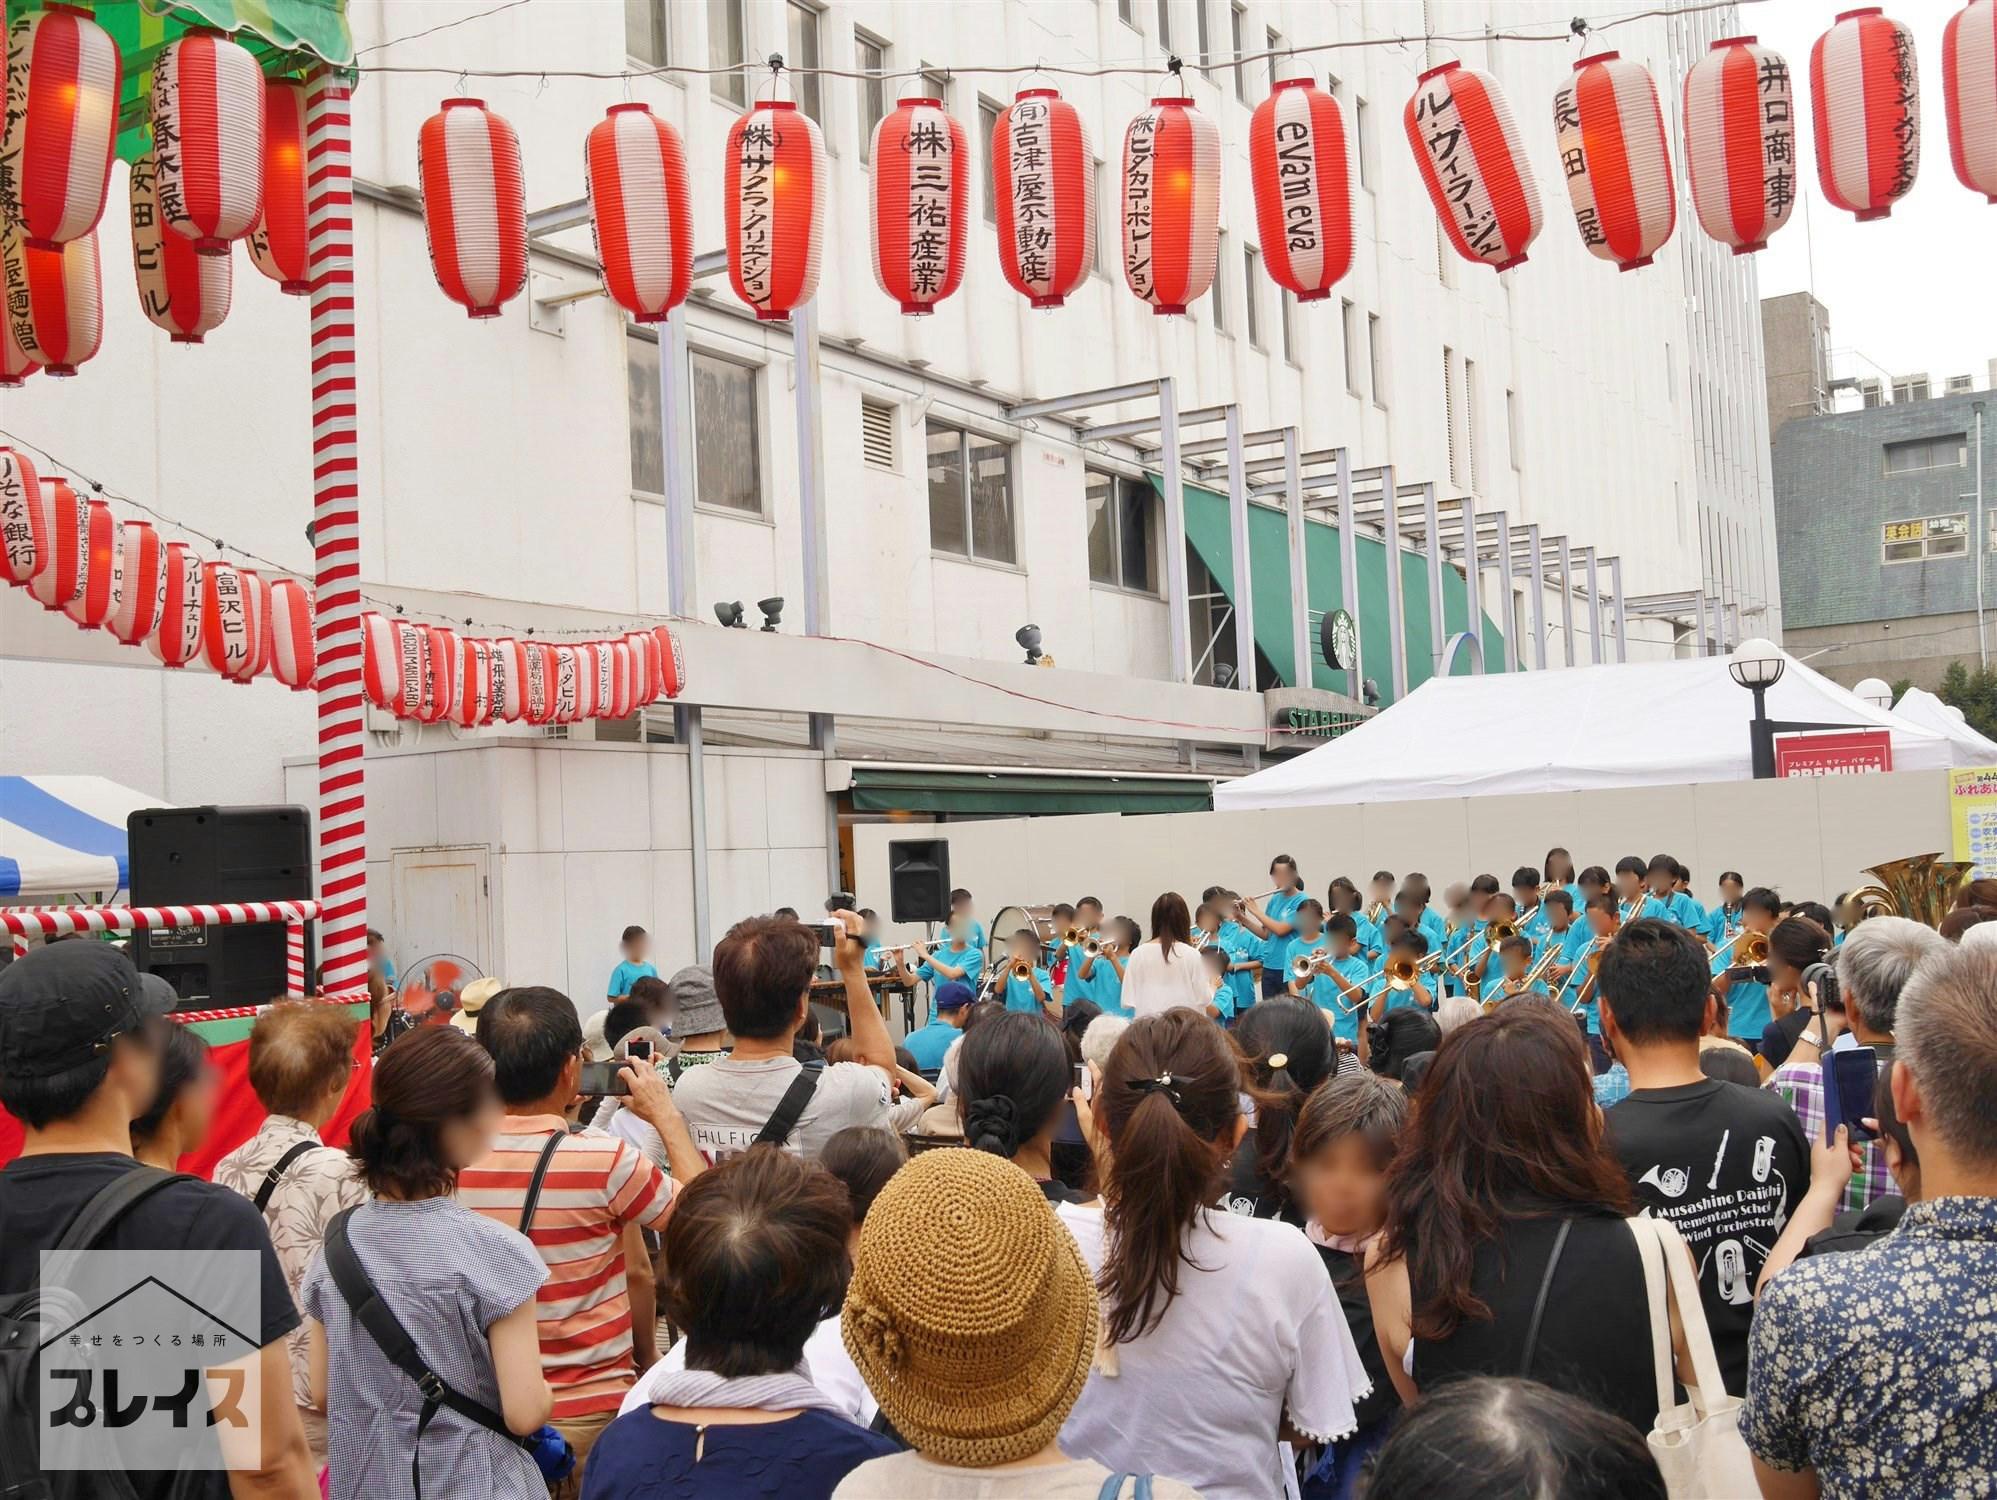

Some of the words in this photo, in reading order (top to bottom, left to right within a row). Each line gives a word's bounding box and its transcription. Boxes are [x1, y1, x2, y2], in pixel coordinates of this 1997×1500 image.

[1415, 92, 1502, 257] ル・ヴィラージュ
[1554, 88, 1607, 249] 長田屋
[1756, 56, 1796, 219] 井口商事
[131, 157, 172, 318] 安田ビル
[1286, 205, 1316, 254] eva
[184, 555, 203, 657] フルーチェリー
[215, 572, 248, 660] 富沢ビル
[558, 652, 577, 713] シバタビル
[1656, 1194, 1735, 1220] Musashino
[1715, 1217, 1775, 1234] Orchestra
